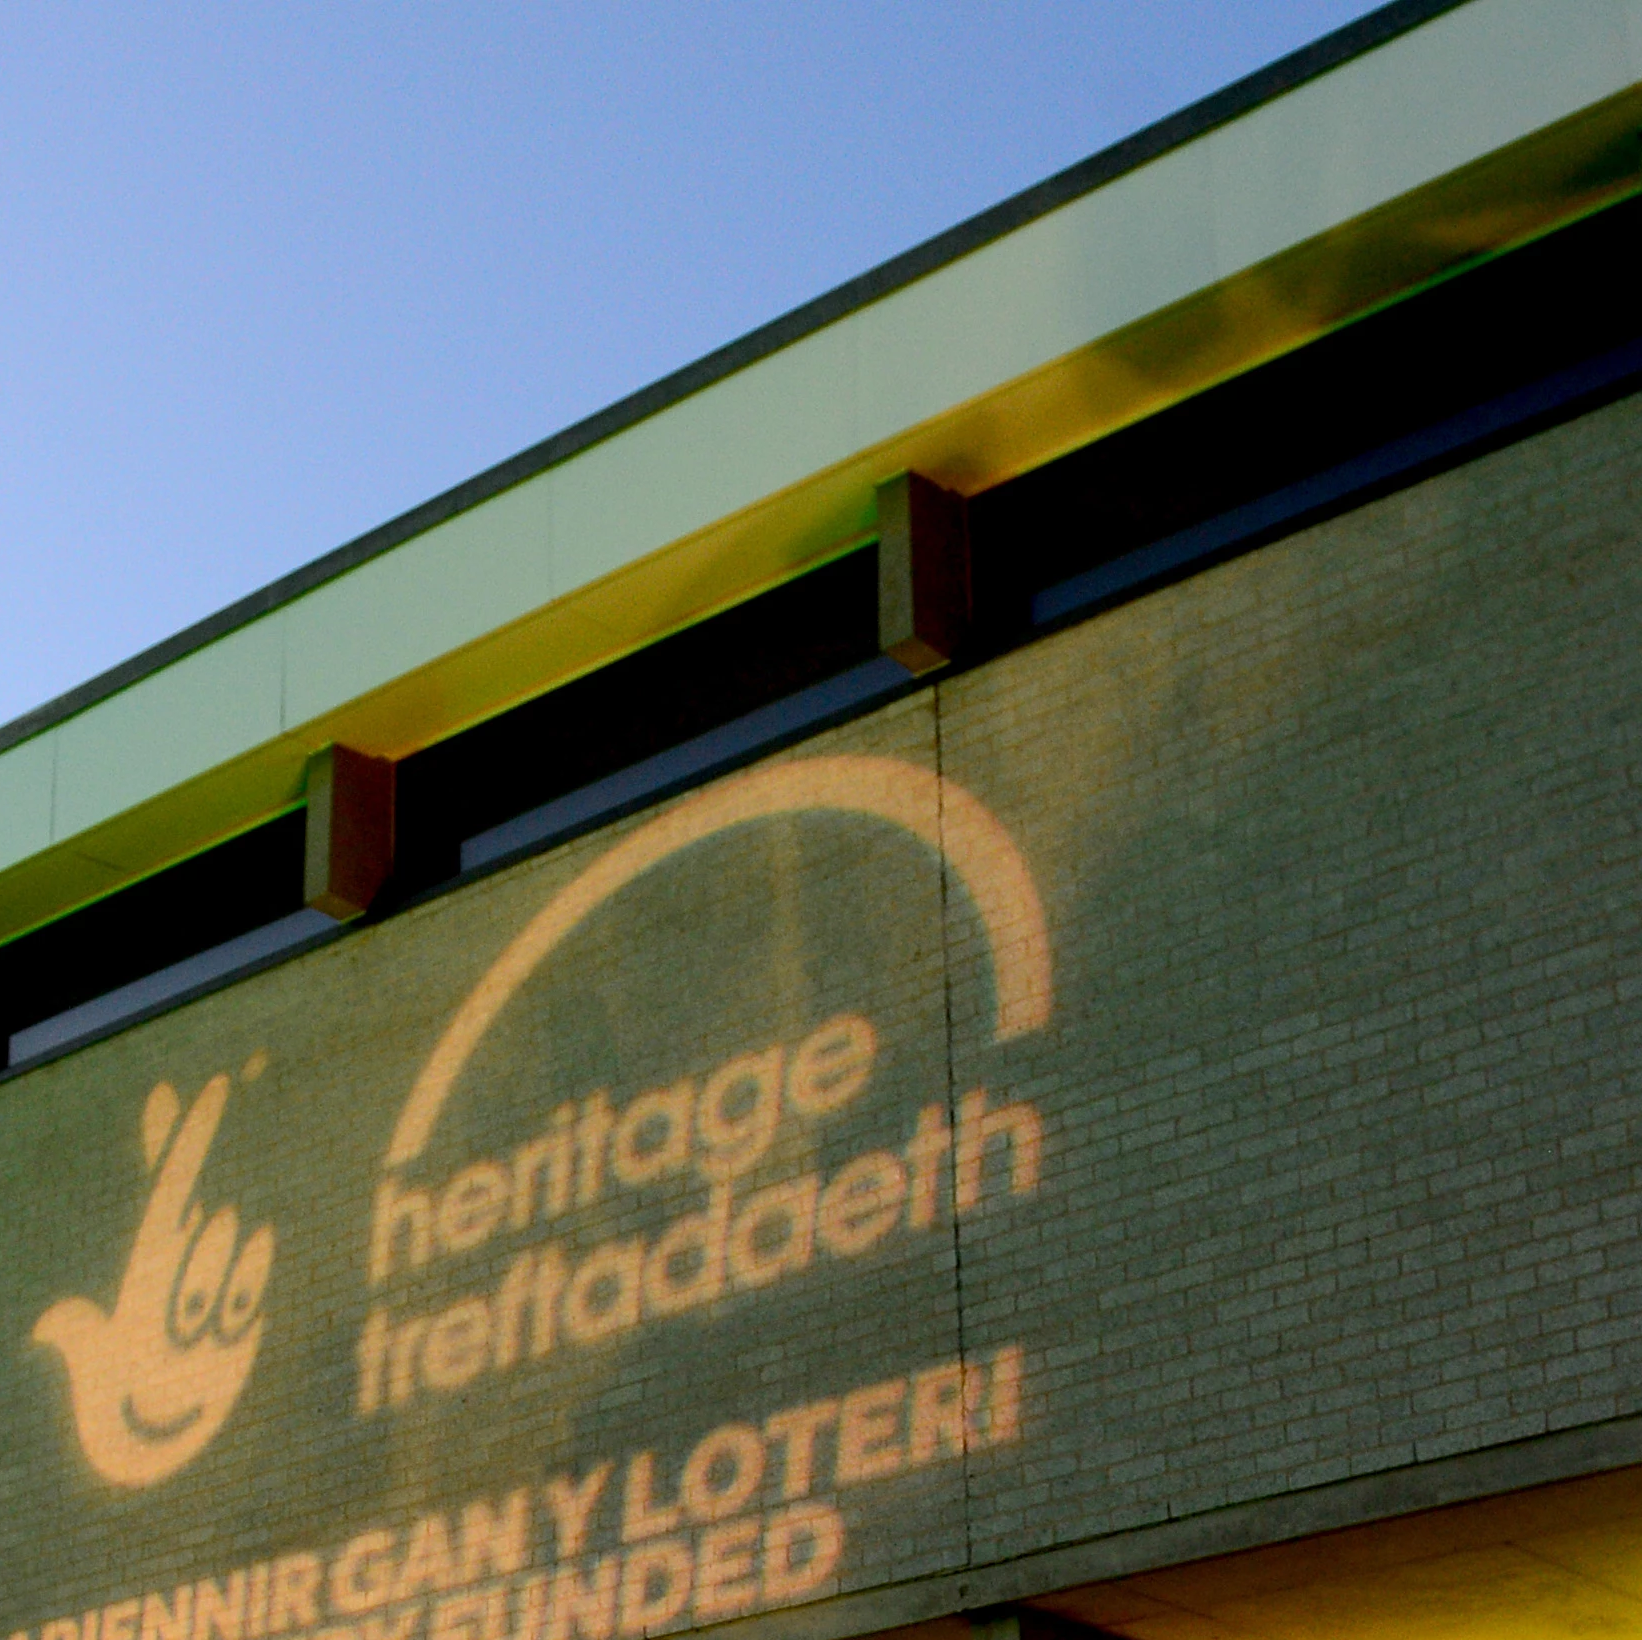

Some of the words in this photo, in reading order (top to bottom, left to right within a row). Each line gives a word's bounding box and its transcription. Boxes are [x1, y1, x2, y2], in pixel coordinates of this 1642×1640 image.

[357, 1086, 1044, 1413] treftadaeth
[369, 1012, 878, 1283] heritage
[329, 1486, 531, 1614] GAN
[548, 1456, 616, 1558] Y
[621, 1343, 1025, 1544] LOTERI
